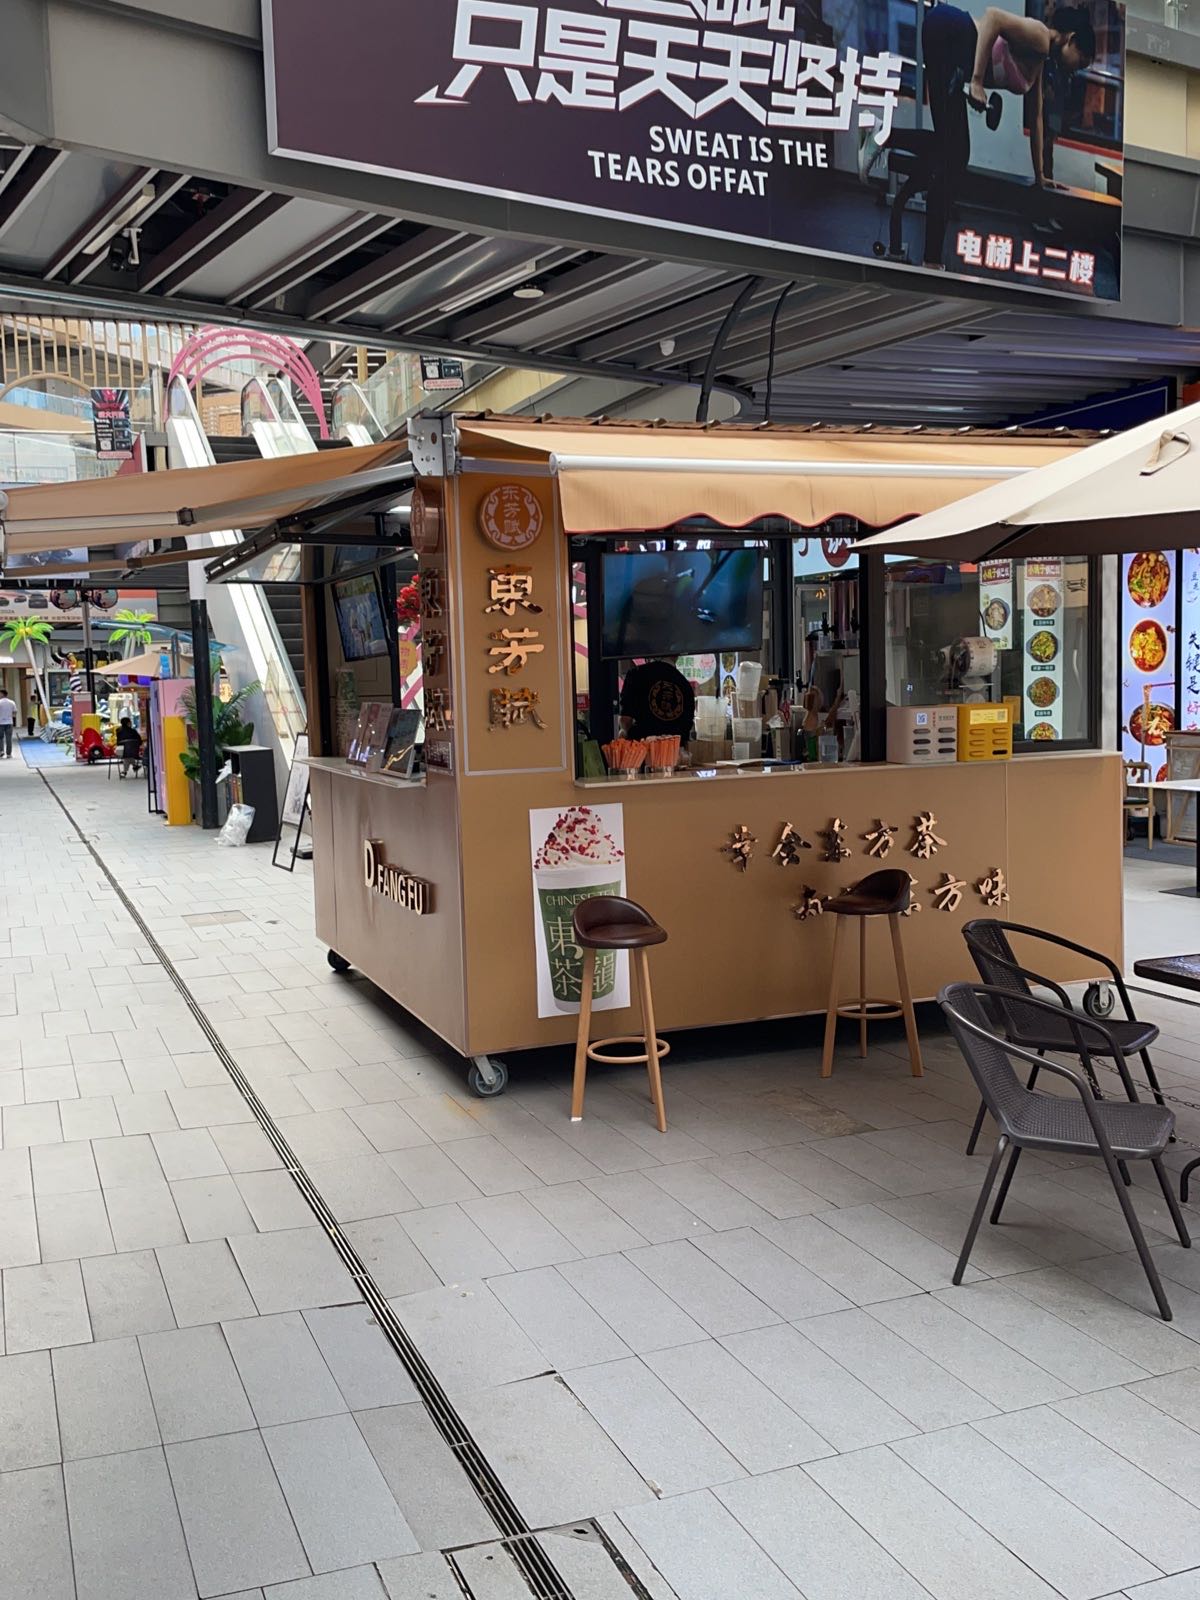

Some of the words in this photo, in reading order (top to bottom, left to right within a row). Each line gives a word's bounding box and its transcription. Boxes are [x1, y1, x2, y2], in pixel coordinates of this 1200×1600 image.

[414, 0, 902, 146] 只是天天坚持
[586, 149, 681, 188] TEARS
[686, 162, 769, 197] OFFAT
[648, 125, 743, 161] SWEAT
[748, 135, 775, 164] IS
[777, 138, 830, 169] THE
[956, 228, 1096, 286] 电梯上二楼
